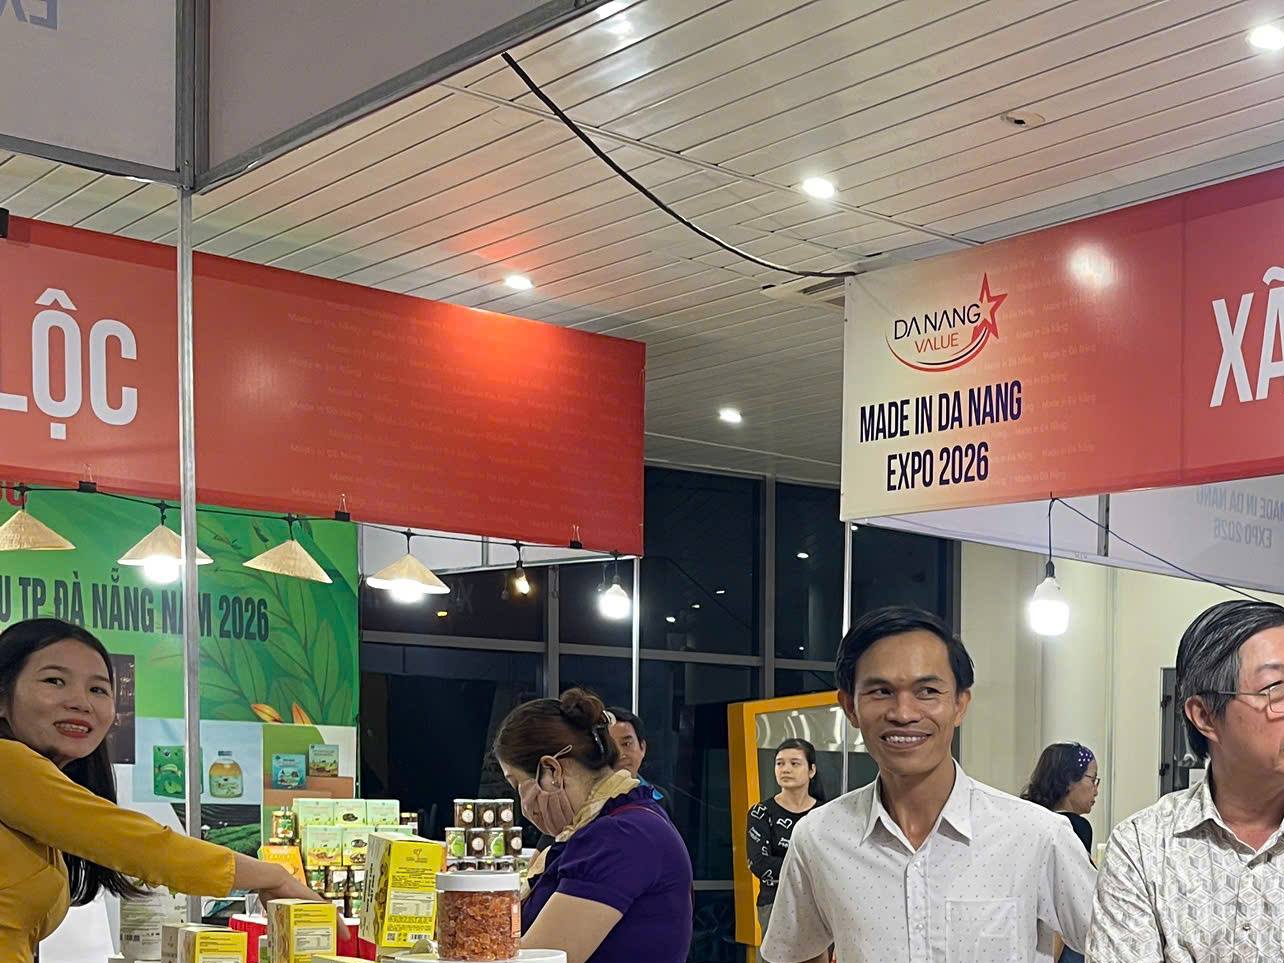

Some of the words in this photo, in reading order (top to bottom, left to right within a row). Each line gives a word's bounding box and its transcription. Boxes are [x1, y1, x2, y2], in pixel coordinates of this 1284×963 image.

[0, 288, 138, 440] ỘC
[914, 332, 960, 353] VALUE
[860, 399, 910, 442] MADE
[915, 394, 932, 435] IN
[938, 390, 963, 431] DA
[968, 380, 1022, 427] NANG
[887, 449, 933, 491] EXPO
[939, 441, 989, 485] 2026
[19, 577, 47, 619] TP
[92, 568, 154, 633] NẴNG
[161, 590, 212, 638] NM
[218, 598, 269, 641] 2026
